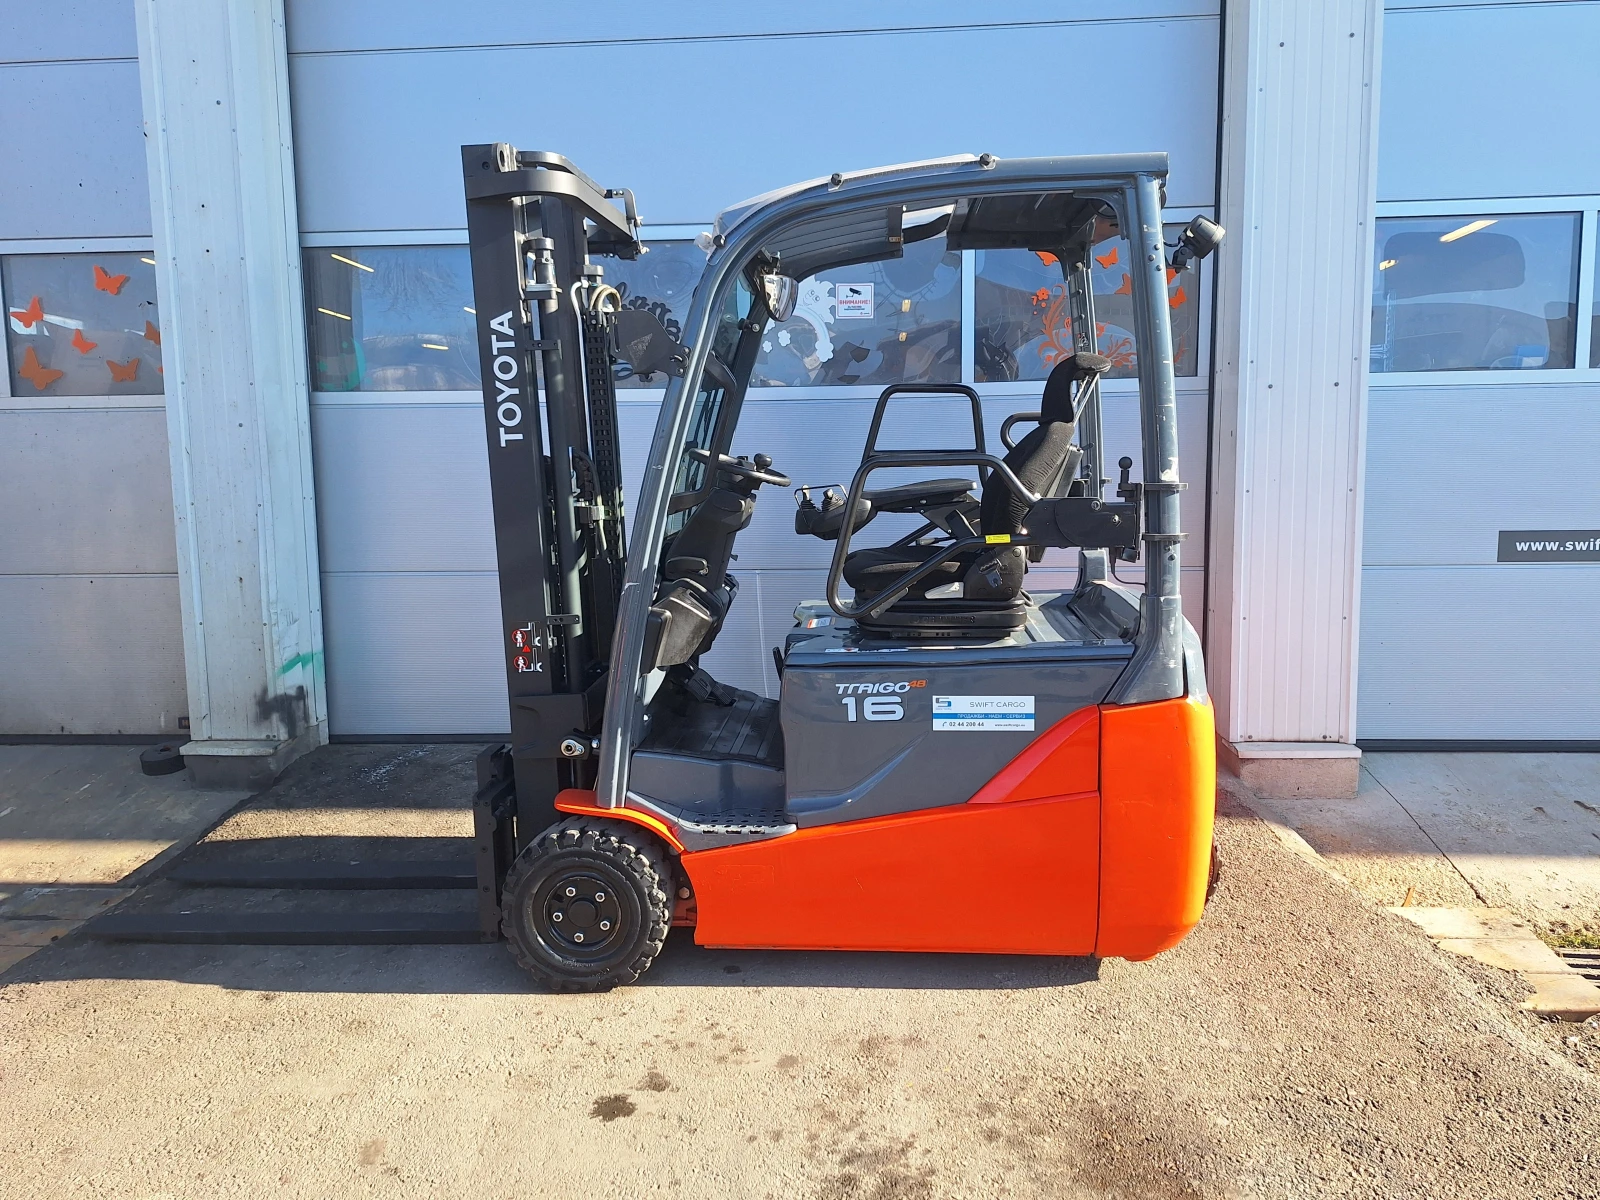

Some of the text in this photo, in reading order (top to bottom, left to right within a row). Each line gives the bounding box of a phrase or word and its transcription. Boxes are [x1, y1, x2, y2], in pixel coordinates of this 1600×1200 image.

[490, 310, 524, 447] TOYOTA
[835, 679, 927, 695] TRAIGO 48
[841, 696, 904, 722] 16
